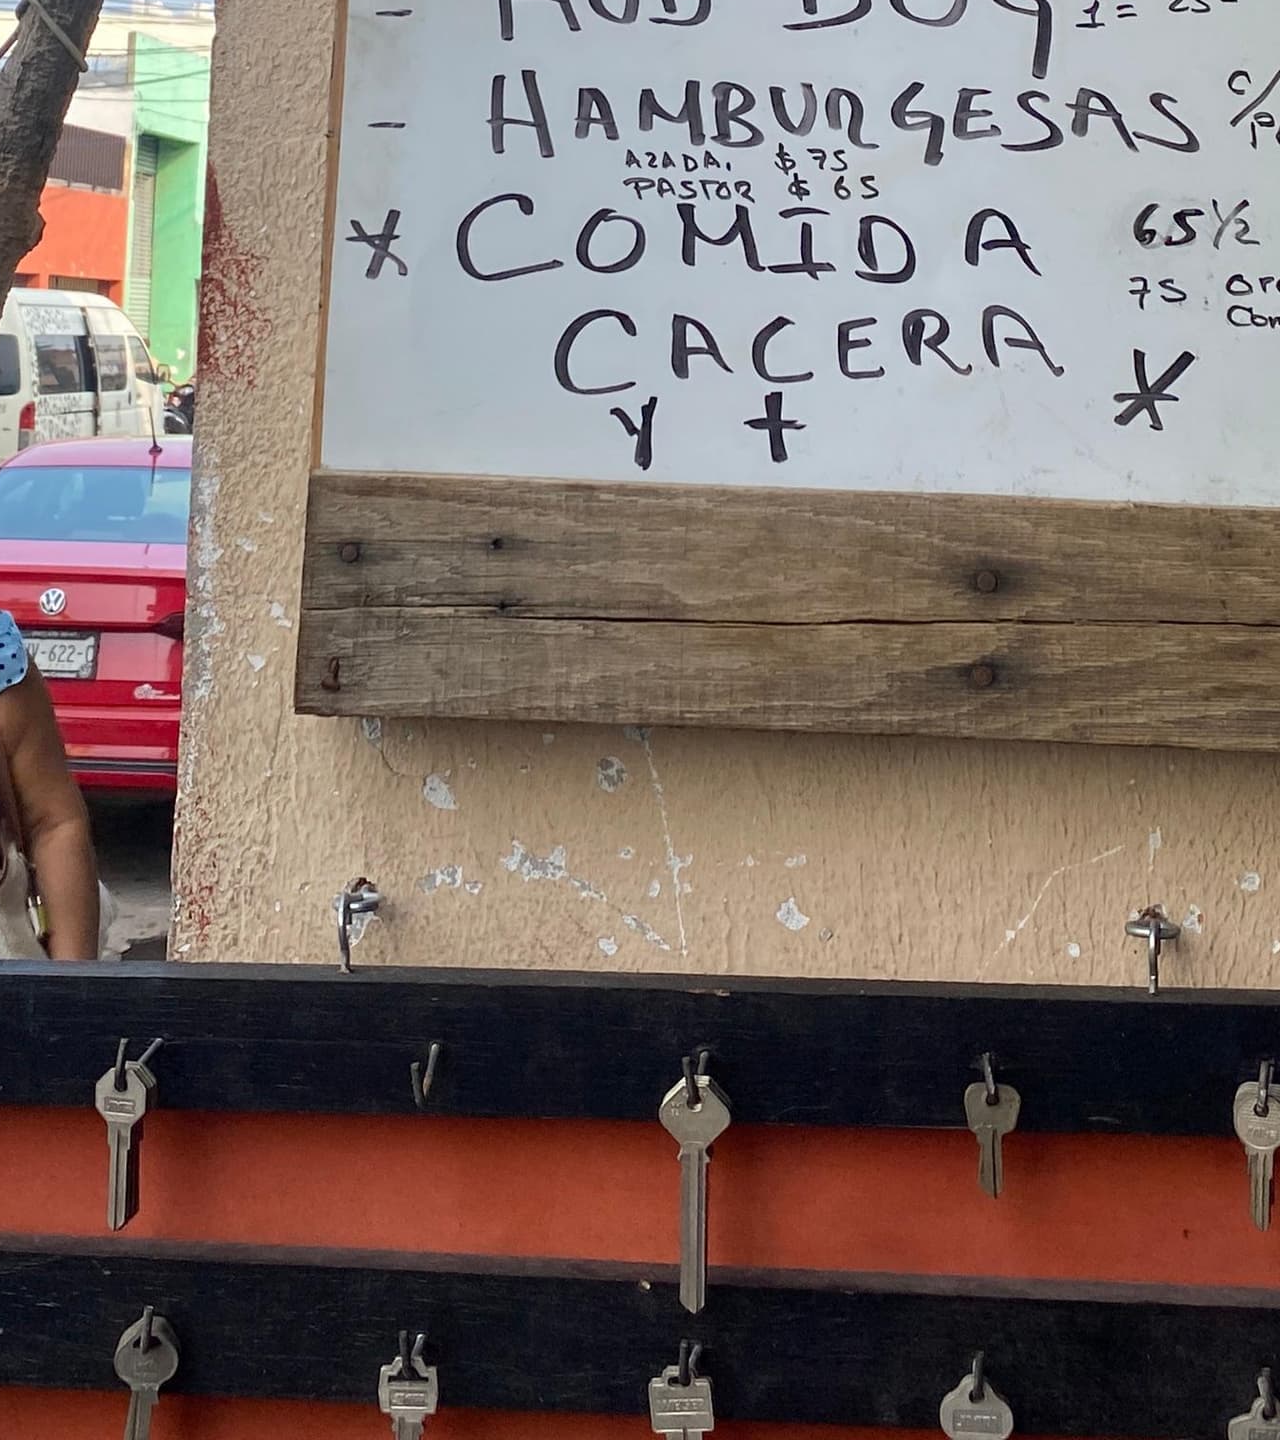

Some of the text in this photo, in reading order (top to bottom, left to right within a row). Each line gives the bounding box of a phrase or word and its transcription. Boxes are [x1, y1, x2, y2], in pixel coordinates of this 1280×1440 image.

[486, 70, 1200, 172] HAMBURGESAS
[623, 177, 755, 203] PASTOR
[456, 193, 1042, 284] COMIDA
[1129, 277, 1187, 310] 75
[554, 305, 1064, 395] CACERA
